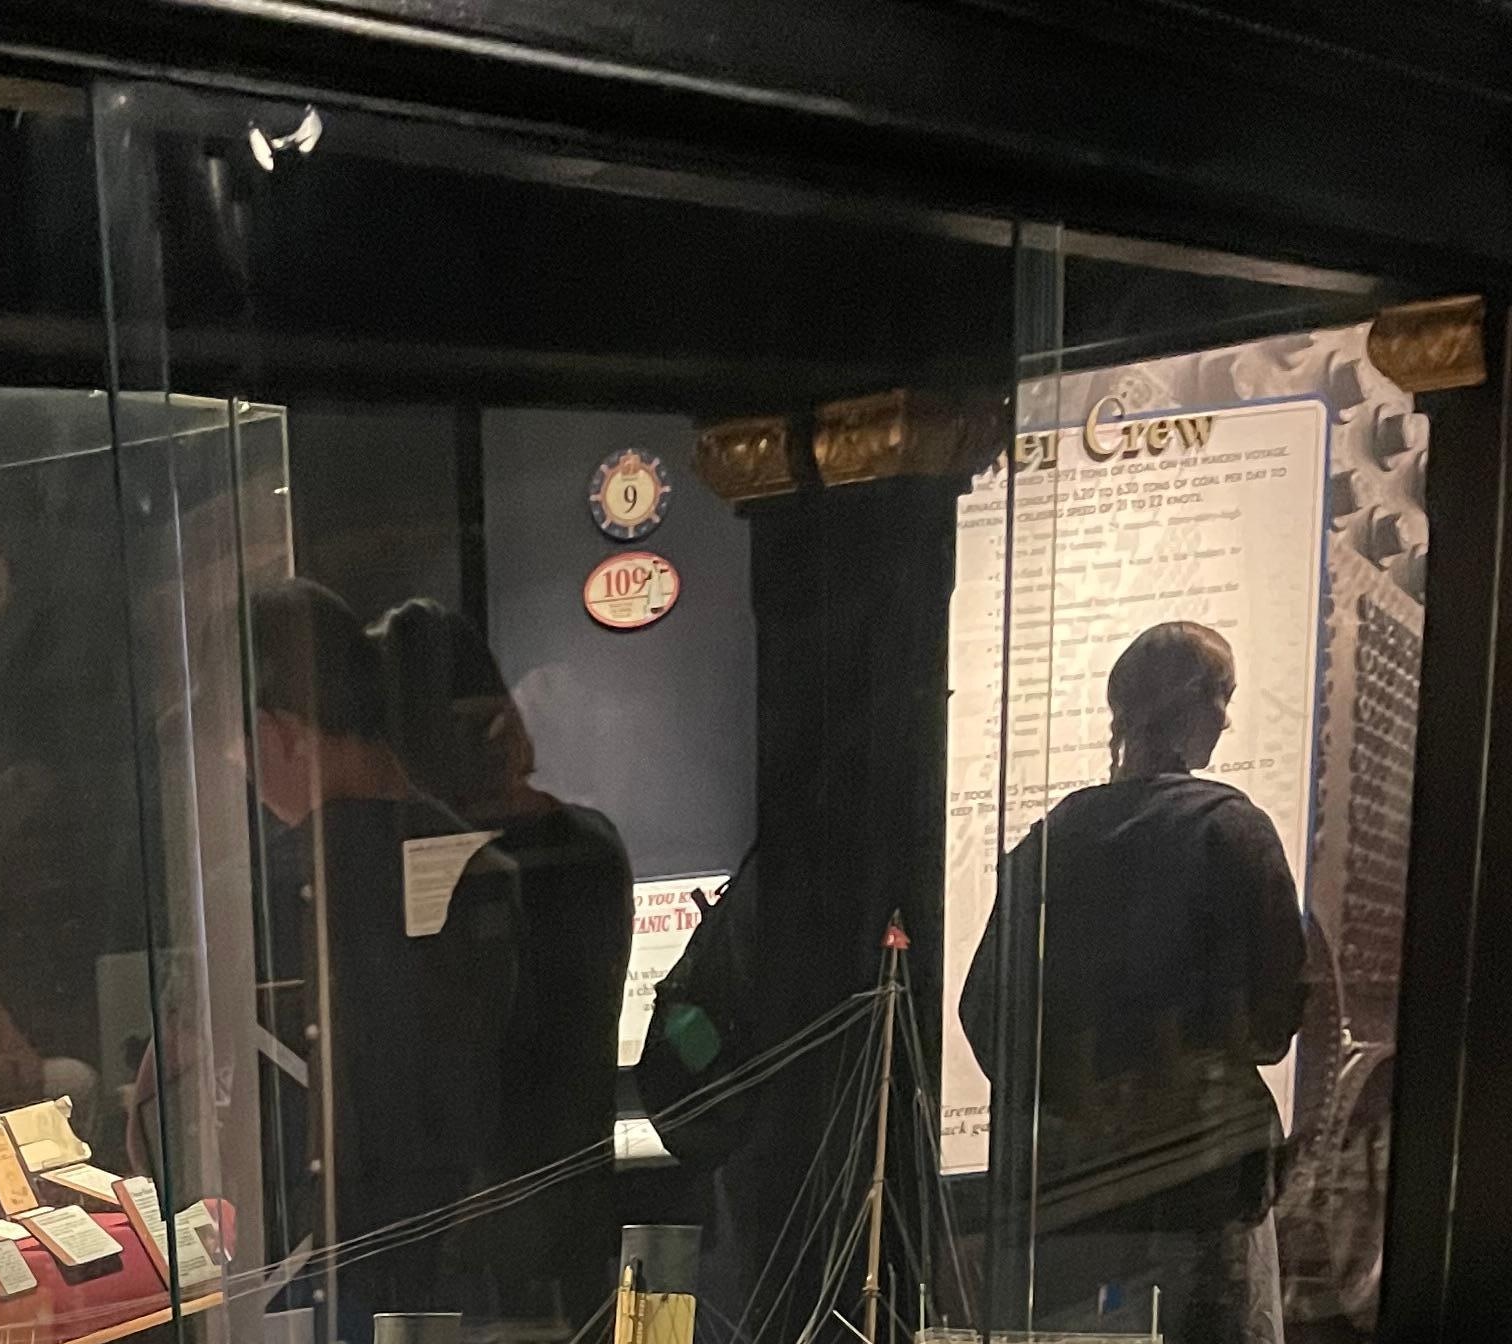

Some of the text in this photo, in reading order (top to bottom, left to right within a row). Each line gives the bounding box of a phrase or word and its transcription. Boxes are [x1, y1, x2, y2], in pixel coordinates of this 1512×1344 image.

[1081, 396, 1213, 461] Crew
[1111, 464, 1125, 476] OF
[1128, 463, 1156, 474] COAL
[1099, 487, 1113, 497] TO
[1174, 479, 1187, 489] OF
[1192, 475, 1219, 487] COAL
[1225, 472, 1242, 483] PER
[1271, 467, 1287, 478] TO
[623, 485, 639, 513] 9
[1099, 503, 1114, 513] OF
[1220, 761, 1255, 773] CLOCK
[1259, 758, 1275, 769] TO
[647, 892, 676, 907] YOU
